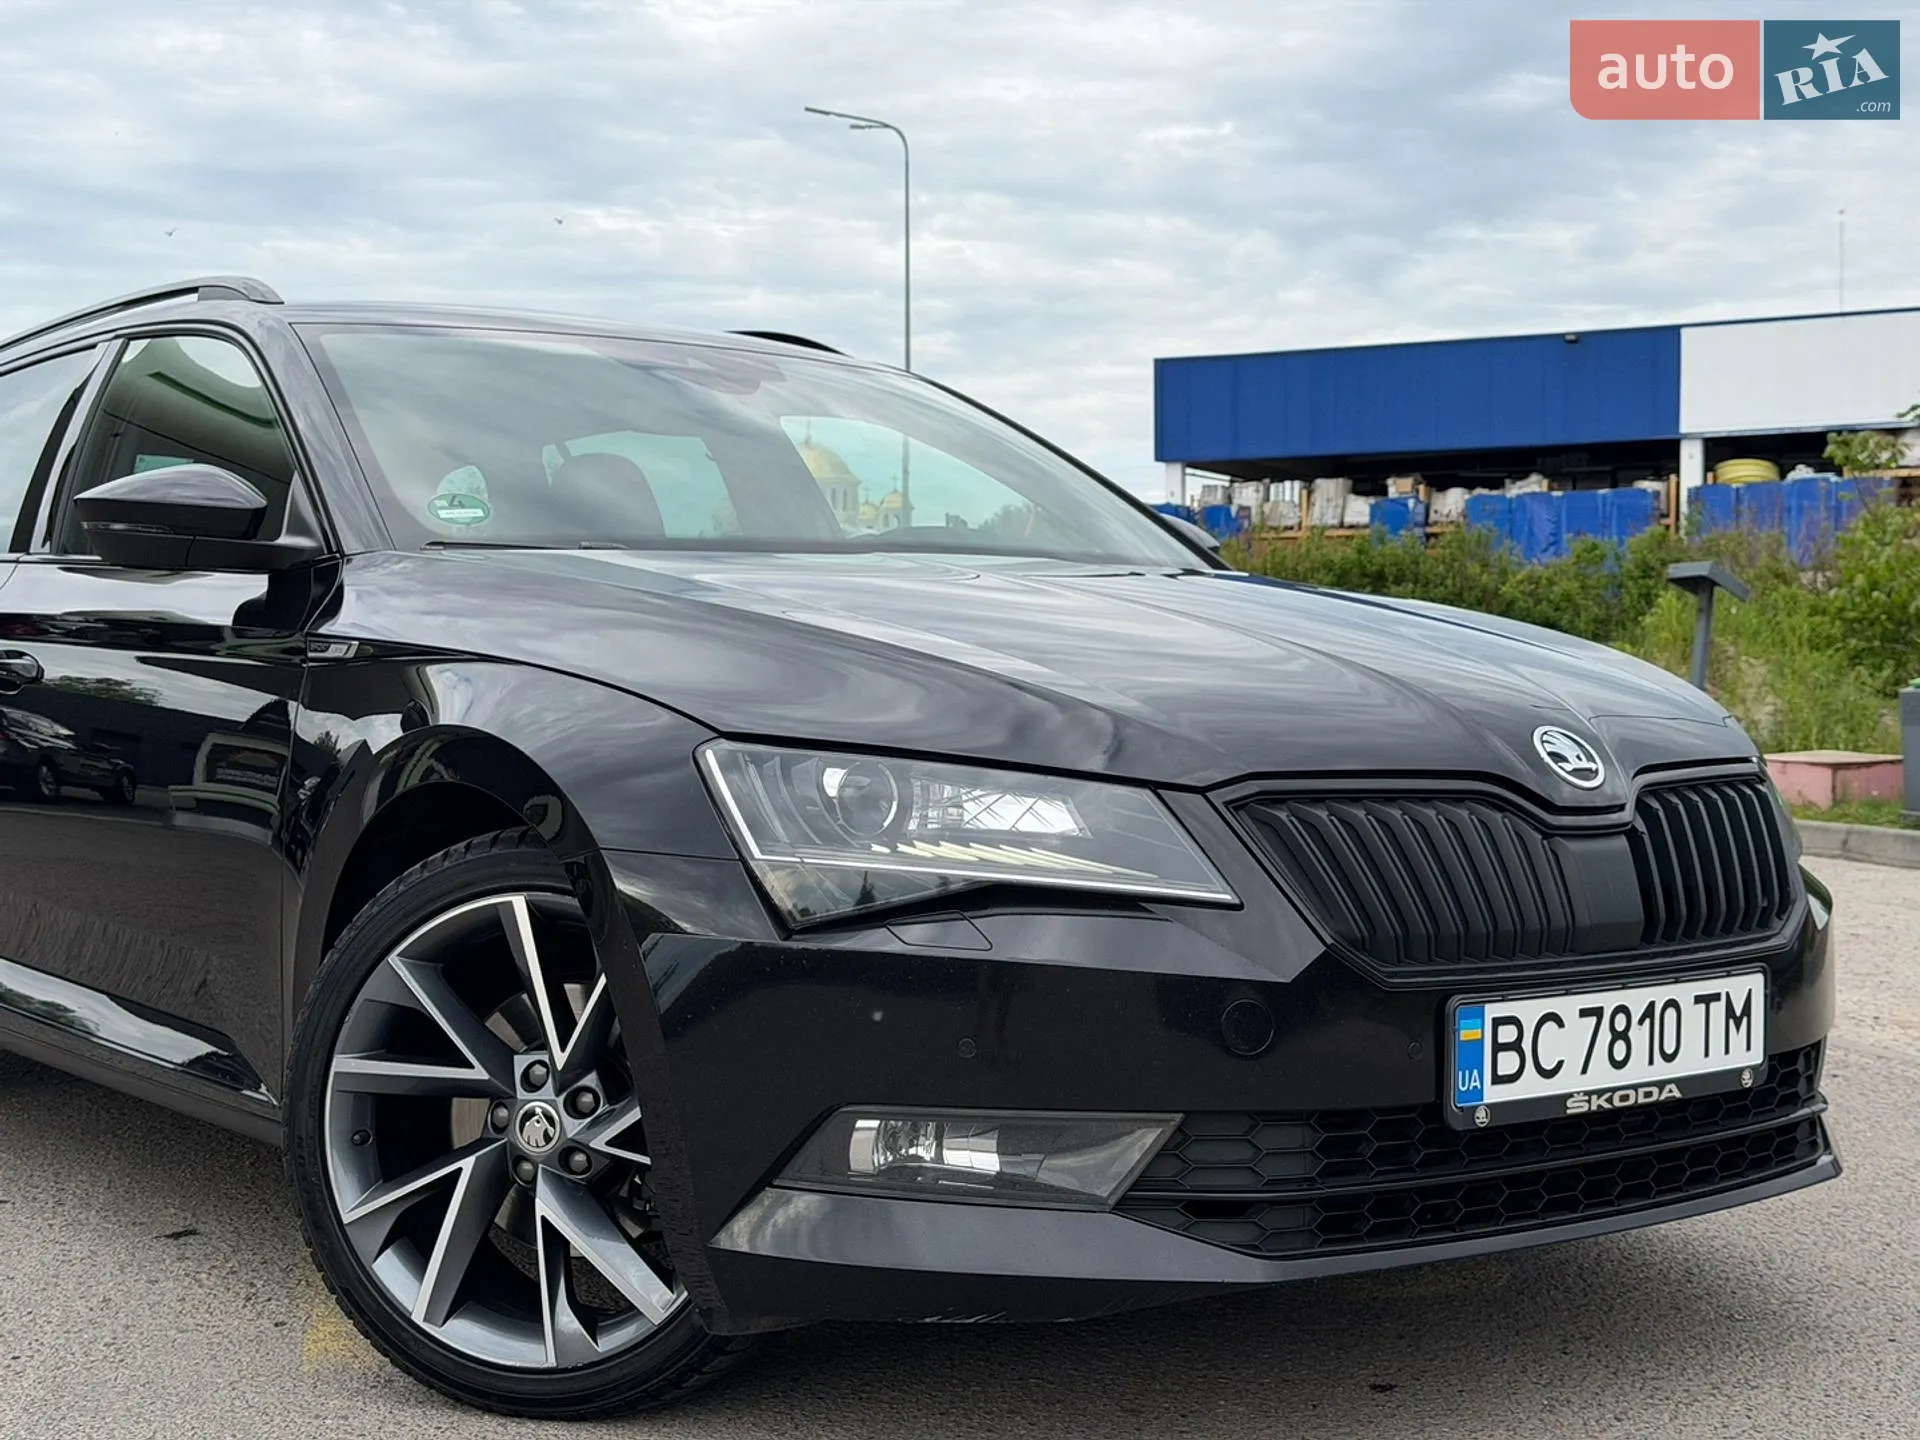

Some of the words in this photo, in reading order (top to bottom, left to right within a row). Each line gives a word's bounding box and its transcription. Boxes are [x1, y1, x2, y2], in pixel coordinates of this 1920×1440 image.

[1490, 1011, 1566, 1086] BC
[1578, 997, 1682, 1076] 7810
[1693, 987, 1753, 1059] TM
[1458, 1069, 1482, 1092] UA
[1566, 1083, 1682, 1114] ŠKODA
